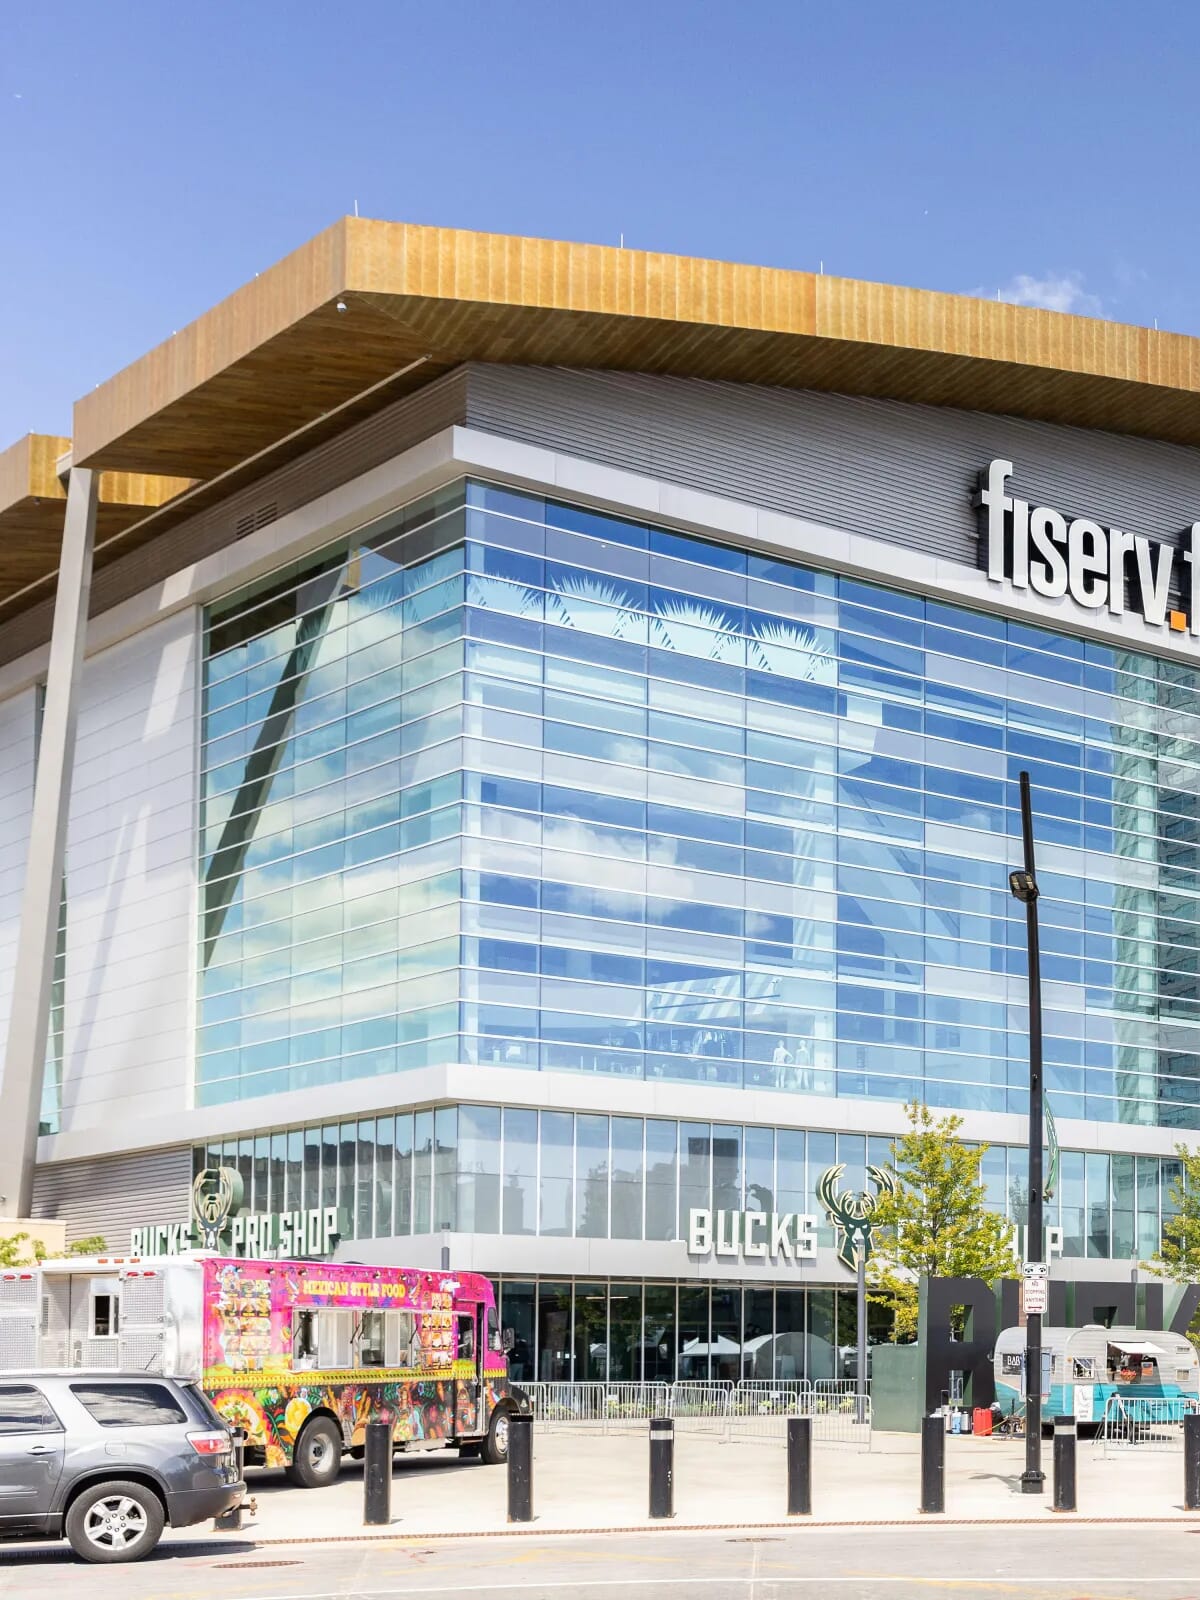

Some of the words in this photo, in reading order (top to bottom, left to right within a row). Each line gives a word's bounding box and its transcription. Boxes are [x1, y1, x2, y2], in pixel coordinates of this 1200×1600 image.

[131, 1223, 192, 1256] BUCKS
[231, 1213, 274, 1258] PRO
[279, 1206, 339, 1258] SHOP
[687, 1208, 818, 1259] BUCKS
[303, 1280, 348, 1296] MEXICAN
[351, 1281, 380, 1297] STYLE
[381, 1282, 406, 1298] FOOD
